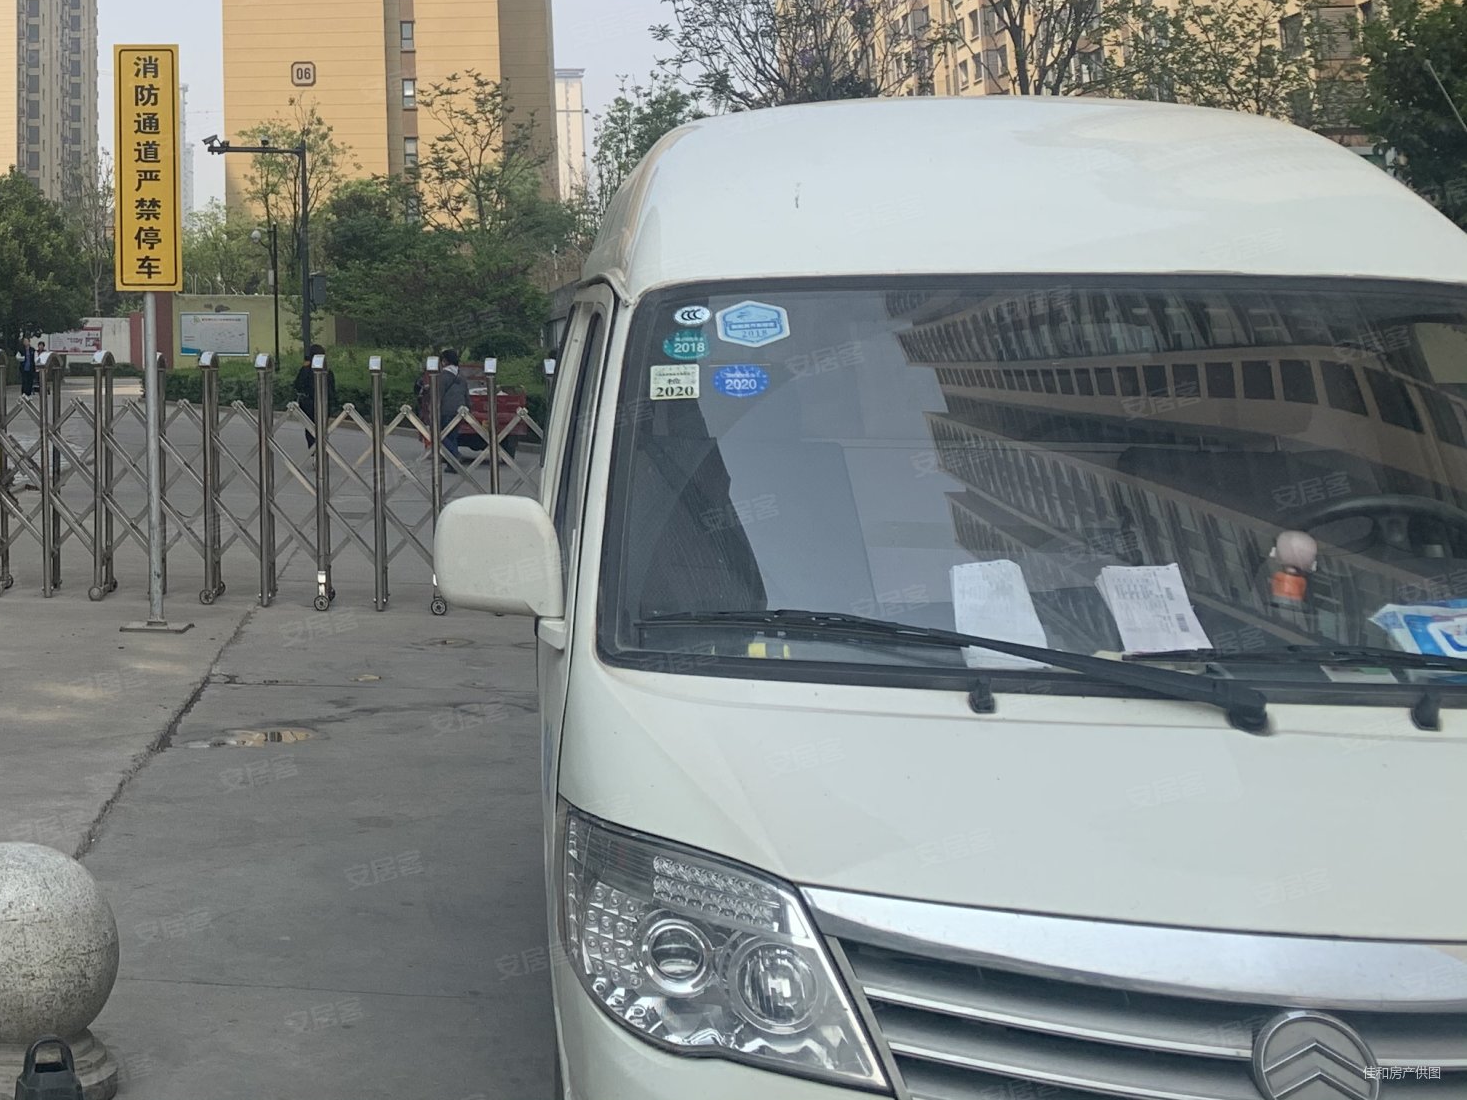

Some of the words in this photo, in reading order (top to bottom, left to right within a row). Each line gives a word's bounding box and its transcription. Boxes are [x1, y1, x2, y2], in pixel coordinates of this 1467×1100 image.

[296, 67, 311, 80] 06
[134, 55, 163, 280] 消防通道严禁停车
[742, 329, 769, 338] 2018
[674, 342, 705, 353] 2018
[725, 379, 757, 390] 2020
[655, 386, 695, 398] 2020
